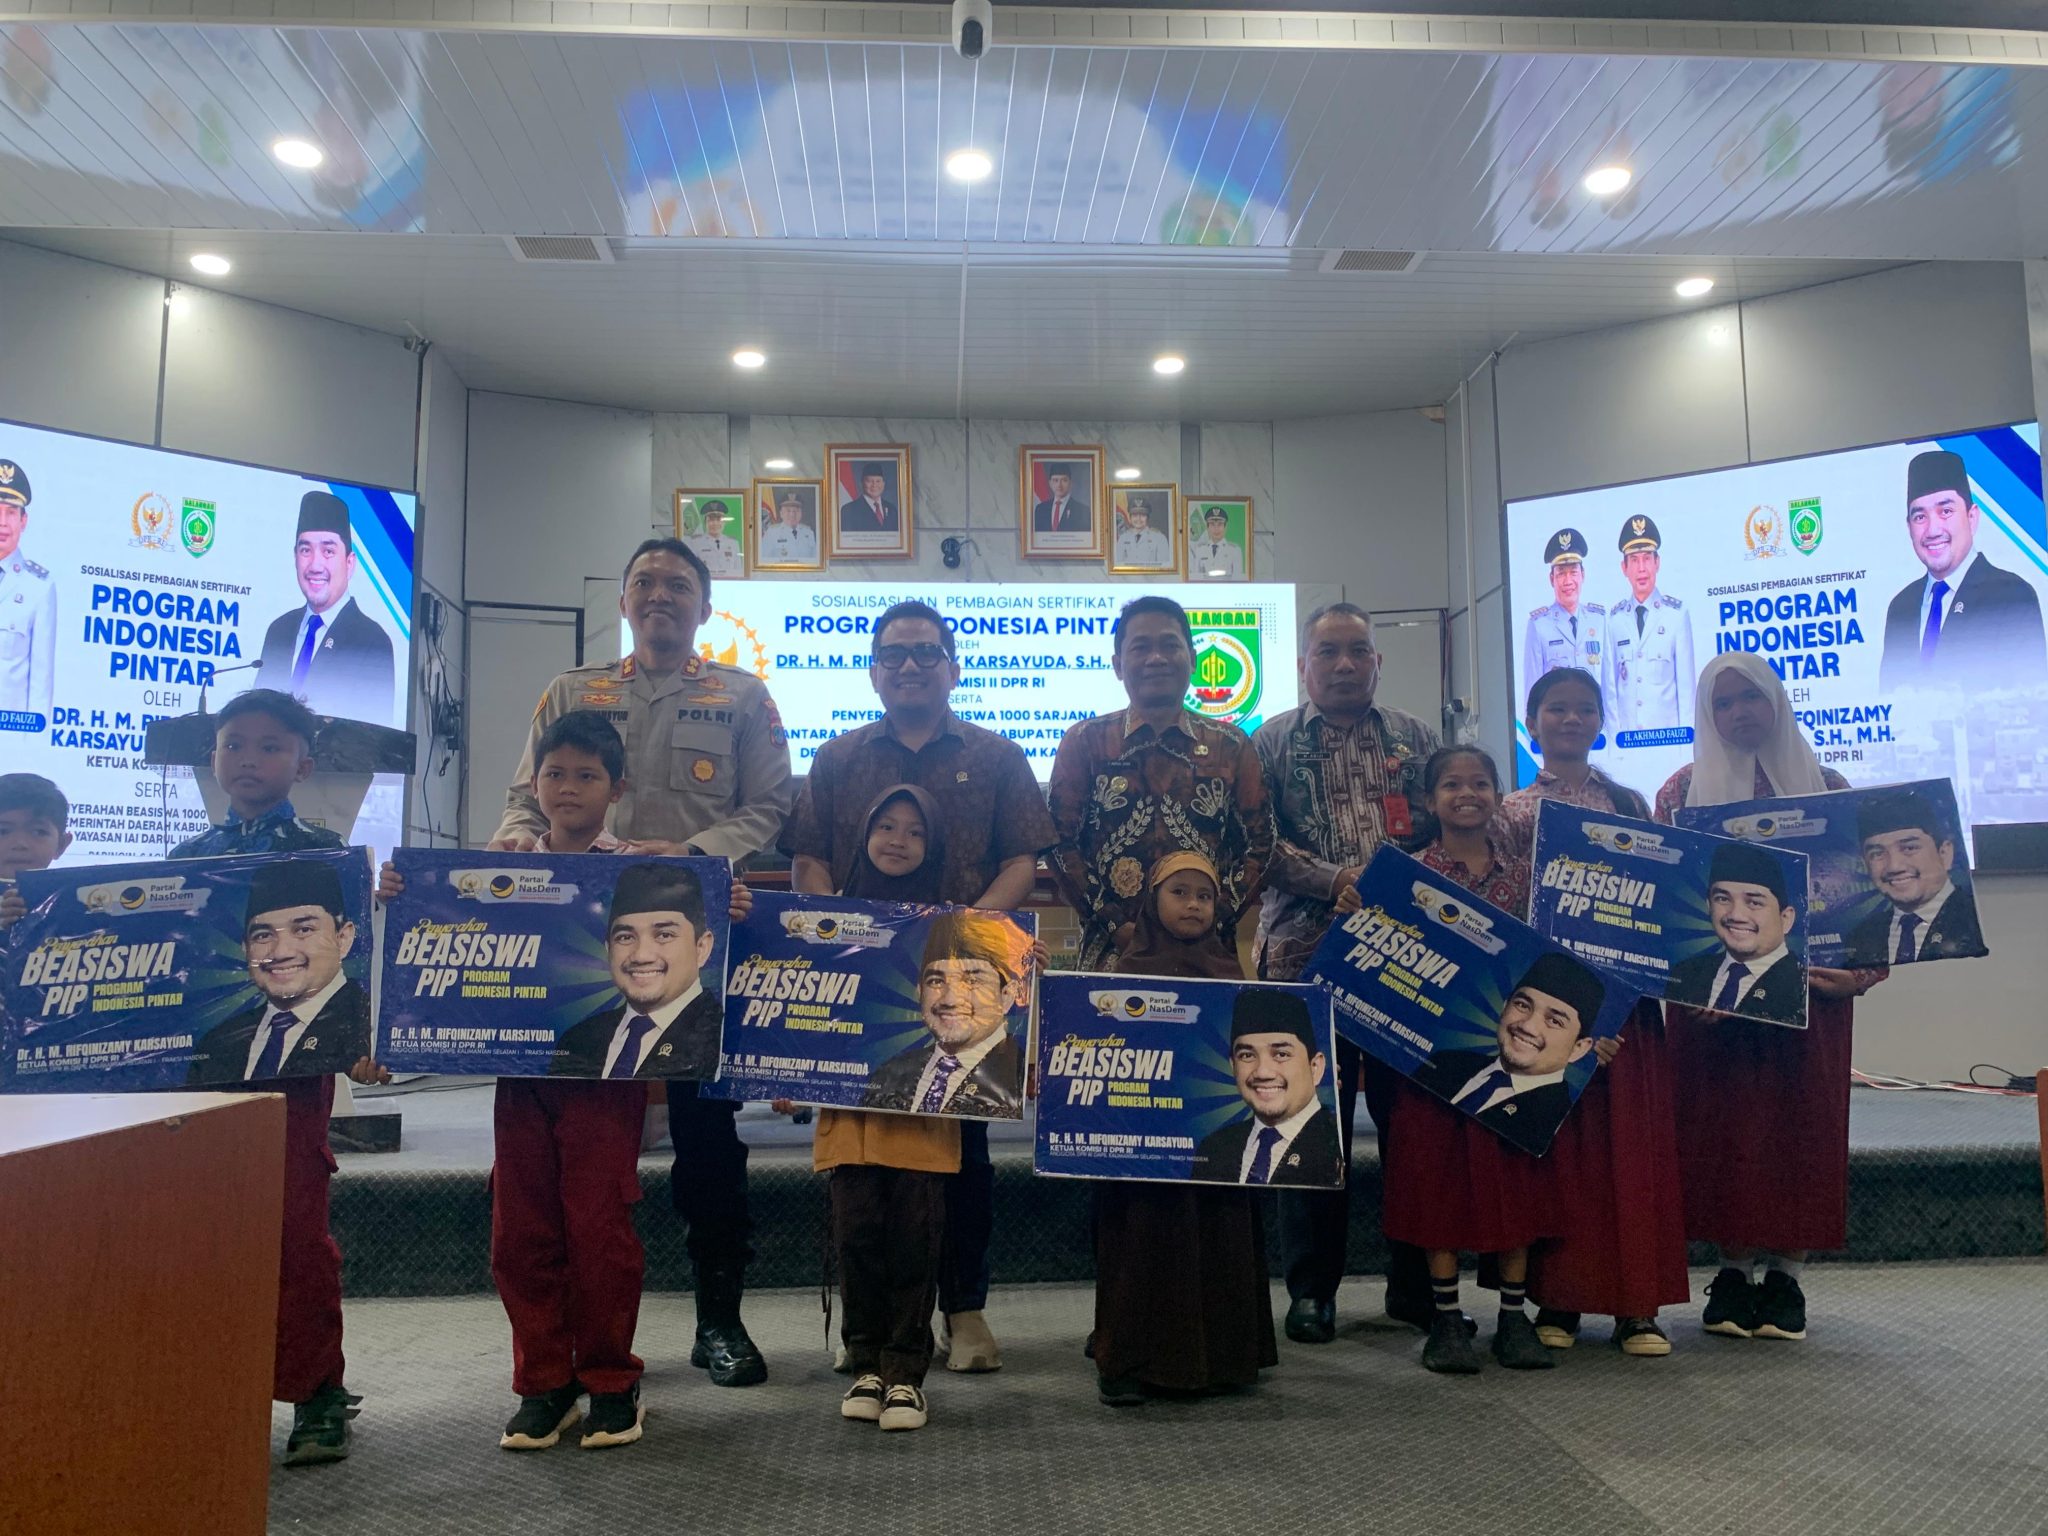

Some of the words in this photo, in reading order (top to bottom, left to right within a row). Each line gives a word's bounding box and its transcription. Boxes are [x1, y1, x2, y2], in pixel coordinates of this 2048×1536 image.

[81, 565, 141, 582] SOSIALISASI
[143, 573, 199, 590] PEMBAGIAN
[200, 580, 252, 596] SERTIFIKAT
[1707, 582, 1759, 596] SOSIALISASI
[1761, 578, 1813, 591] PEMBAGIAN
[1815, 570, 1867, 584] SERTIFIKAT
[91, 583, 240, 627] PROGRAM
[812, 595, 900, 608] SOSIALISASI
[946, 596, 1033, 609] PEMBAGIAN
[1038, 597, 1115, 609] SERTIFIKAT
[1719, 587, 1857, 627] PROGRAM
[785, 616, 881, 634] PROGR
[943, 617, 1049, 635] DONESIA
[1056, 617, 1118, 635] PINT
[1187, 612, 1256, 626] LANGAN
[83, 615, 242, 659] INDONESIA
[1716, 618, 1864, 656] INDONESIA
[110, 651, 215, 687] PINTAR
[777, 655, 803, 668] DR.
[808, 655, 824, 668] H.
[829, 655, 848, 668] M.
[964, 655, 1071, 669] KARSAYUDA,
[1076, 655, 1110, 669] S.H.,
[1767, 652, 1840, 681] NTAR
[957, 677, 986, 688] MISI
[989, 677, 997, 688] II
[1001, 677, 1028, 688] DPR
[1032, 677, 1045, 688] RI
[143, 690, 182, 708] OLEH
[948, 694, 983, 704] SERTA
[10, 712, 36, 724] FAUZI
[52, 706, 84, 727] DR.
[91, 710, 109, 729] H.
[114, 712, 136, 731] M.
[678, 709, 733, 724] POLRI
[832, 711, 883, 722] PENYER
[953, 710, 997, 722] SISWA
[1000, 710, 1031, 721] 1000
[1034, 710, 1096, 722] SARJANA
[1793, 704, 1892, 730] FQINIZAMY
[51, 729, 146, 752] KARSAYU
[783, 729, 837, 740] ANTARA
[1624, 732, 1632, 741] H.
[1633, 730, 1666, 740] AKHMAD
[1666, 728, 1687, 738] FAUZI
[1814, 729, 1852, 747] S.H.,
[1857, 725, 1896, 743] M.H.
[86, 755, 129, 770] KETUA
[1824, 751, 1848, 763] DPR
[1852, 749, 1863, 761] RI
[134, 781, 178, 799] SERTA
[126, 806, 179, 819] BEASISWA
[182, 809, 206, 820] 1000
[66, 817, 125, 830] EMERINTAH
[127, 820, 171, 832] DAERAH
[173, 822, 209, 833] KABUP
[1779, 822, 1814, 830] NasDem
[74, 831, 122, 844] YAYASAN
[124, 832, 139, 844] IAI
[140, 833, 176, 845] DARUL
[1637, 836, 1655, 844] Partai
[1636, 843, 1669, 854] NasDem
[150, 883, 176, 892] Partai
[518, 884, 560, 893] NasDem
[1541, 861, 1656, 909] BEASISWA
[150, 892, 193, 902] NasDem
[1556, 892, 1590, 917] PIP
[1594, 900, 1632, 916] PROGRAM
[412, 917, 488, 937] Penyerahan
[1464, 913, 1484, 928] Partai
[1593, 912, 1632, 929] INDONESIA
[1634, 920, 1661, 935] PINTAR
[841, 928, 879, 937] NasDem
[1460, 919, 1493, 943] NasDem
[396, 931, 541, 968] BEASISWA
[1341, 908, 1460, 989] BEASISWA
[1344, 942, 1384, 972] PIP
[20, 942, 176, 986] BEASISWA
[1624, 952, 1669, 970] KARSAYUDA
[415, 970, 458, 997] PIP
[463, 971, 510, 983] PROGRAM
[1384, 961, 1423, 989] PROGRAM
[93, 981, 143, 995] PROGRAM
[461, 985, 510, 999] INDONESIA
[513, 986, 547, 999] PINTAR
[726, 965, 861, 1005] BEASISWA
[41, 985, 88, 1016] PIP
[92, 995, 144, 1012] INDONESIA
[148, 992, 183, 1007] PINTAR
[1378, 972, 1418, 1001] INDONESIA
[1415, 994, 1444, 1017] PINTAR
[742, 1000, 783, 1028] PIP
[787, 1004, 830, 1018] PROGRAM
[1149, 1005, 1185, 1014] NasDem
[391, 1027, 405, 1039] Dr.
[408, 1027, 418, 1039] H.
[421, 1028, 433, 1040] M.
[436, 1028, 497, 1041] RIFQINIZAMY
[499, 1029, 554, 1042] KARSAYUDA
[785, 1017, 830, 1031] INDONESIA
[831, 1019, 863, 1035] PINTAR
[1389, 1020, 1434, 1053] KARSAYUDA
[17, 1048, 32, 1061] Dr.
[35, 1046, 45, 1060] H.
[49, 1045, 62, 1058] M.
[66, 1040, 131, 1057] RIFQINIZAMY
[133, 1034, 193, 1051] KARSAYUDA
[17, 1060, 46, 1069] KETUA
[49, 1059, 81, 1067] KOMISI
[734, 1054, 743, 1065] H.
[745, 1055, 757, 1067] M.
[760, 1056, 816, 1072] RIFQINIZAMY
[817, 1061, 869, 1076] KARSAYUDA
[744, 1068, 772, 1076] KOMISI
[1048, 1045, 1174, 1081] BEASISWA
[1066, 1079, 1103, 1106] PIP
[1108, 1081, 1149, 1094] PROGRAM
[1108, 1094, 1151, 1108] INDONESIA
[1153, 1097, 1183, 1110] PINTAR
[1050, 1132, 1062, 1144] Dr.
[1065, 1133, 1073, 1145] H.
[1075, 1133, 1087, 1145] M.
[1089, 1133, 1142, 1147] RIFQINIZAMY
[1144, 1136, 1194, 1149] KARSAYUDA
[1076, 1145, 1101, 1153] KOMISI
